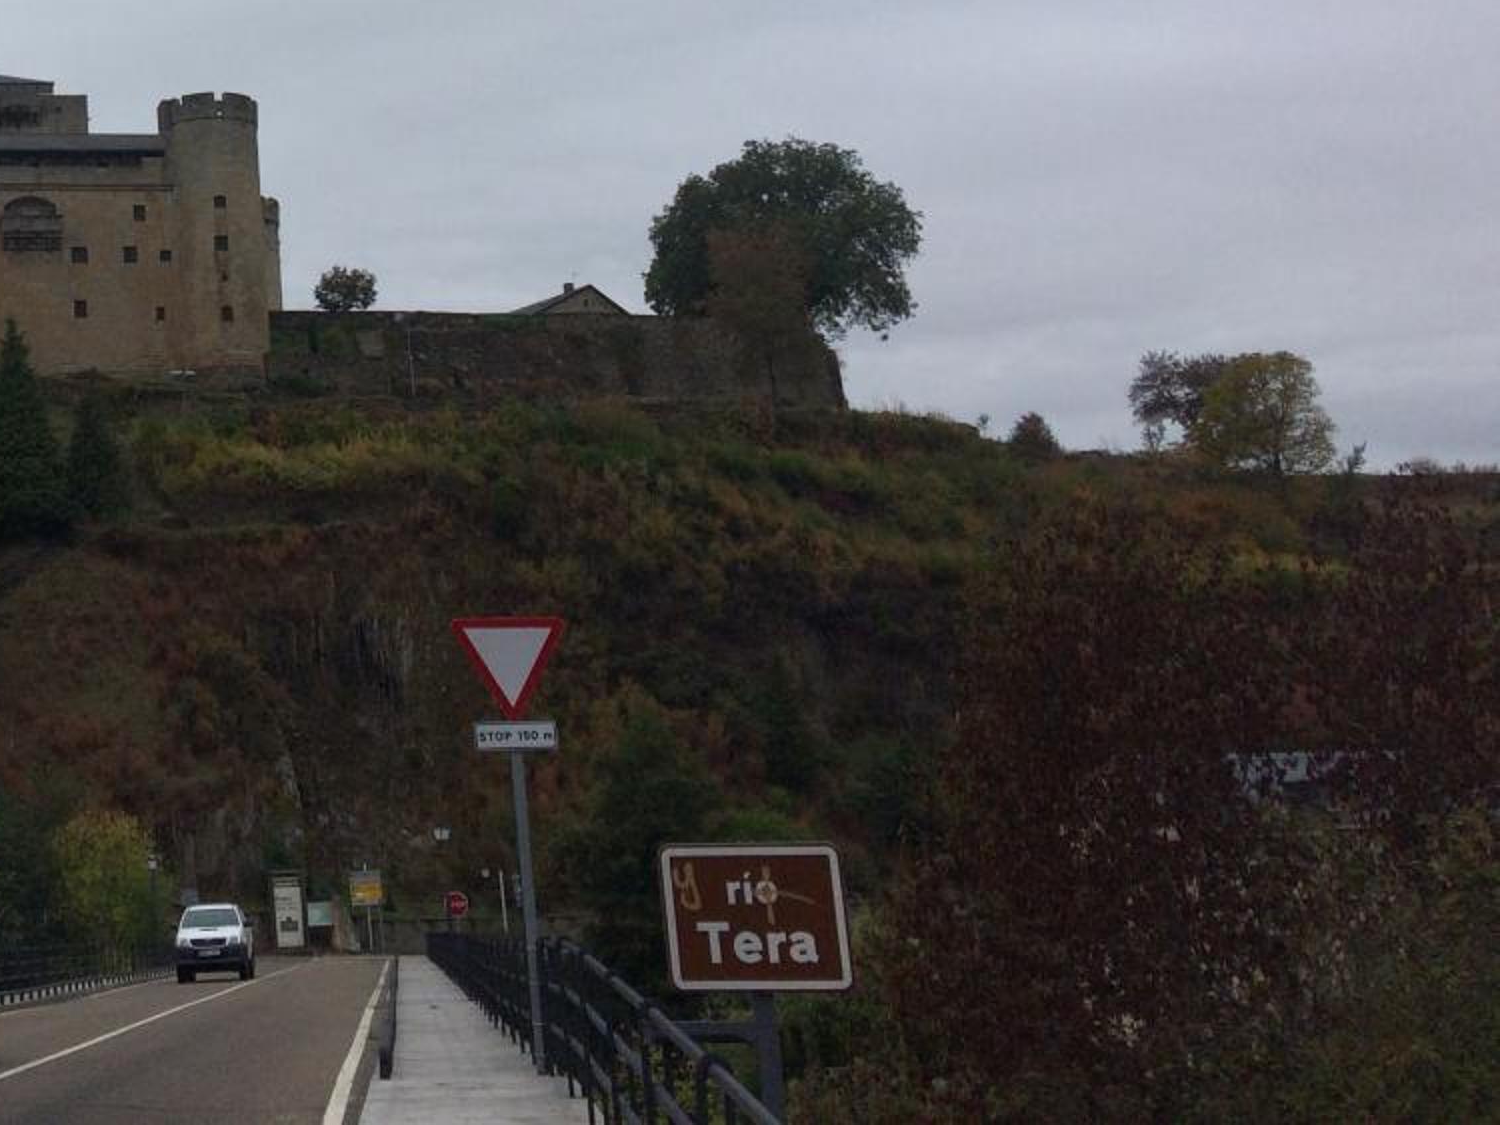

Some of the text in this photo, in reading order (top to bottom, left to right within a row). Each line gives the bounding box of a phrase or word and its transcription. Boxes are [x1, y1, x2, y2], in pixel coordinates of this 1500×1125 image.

[479, 730, 512, 742] STOP
[517, 730, 538, 741] 150
[696, 921, 820, 965] Tera
